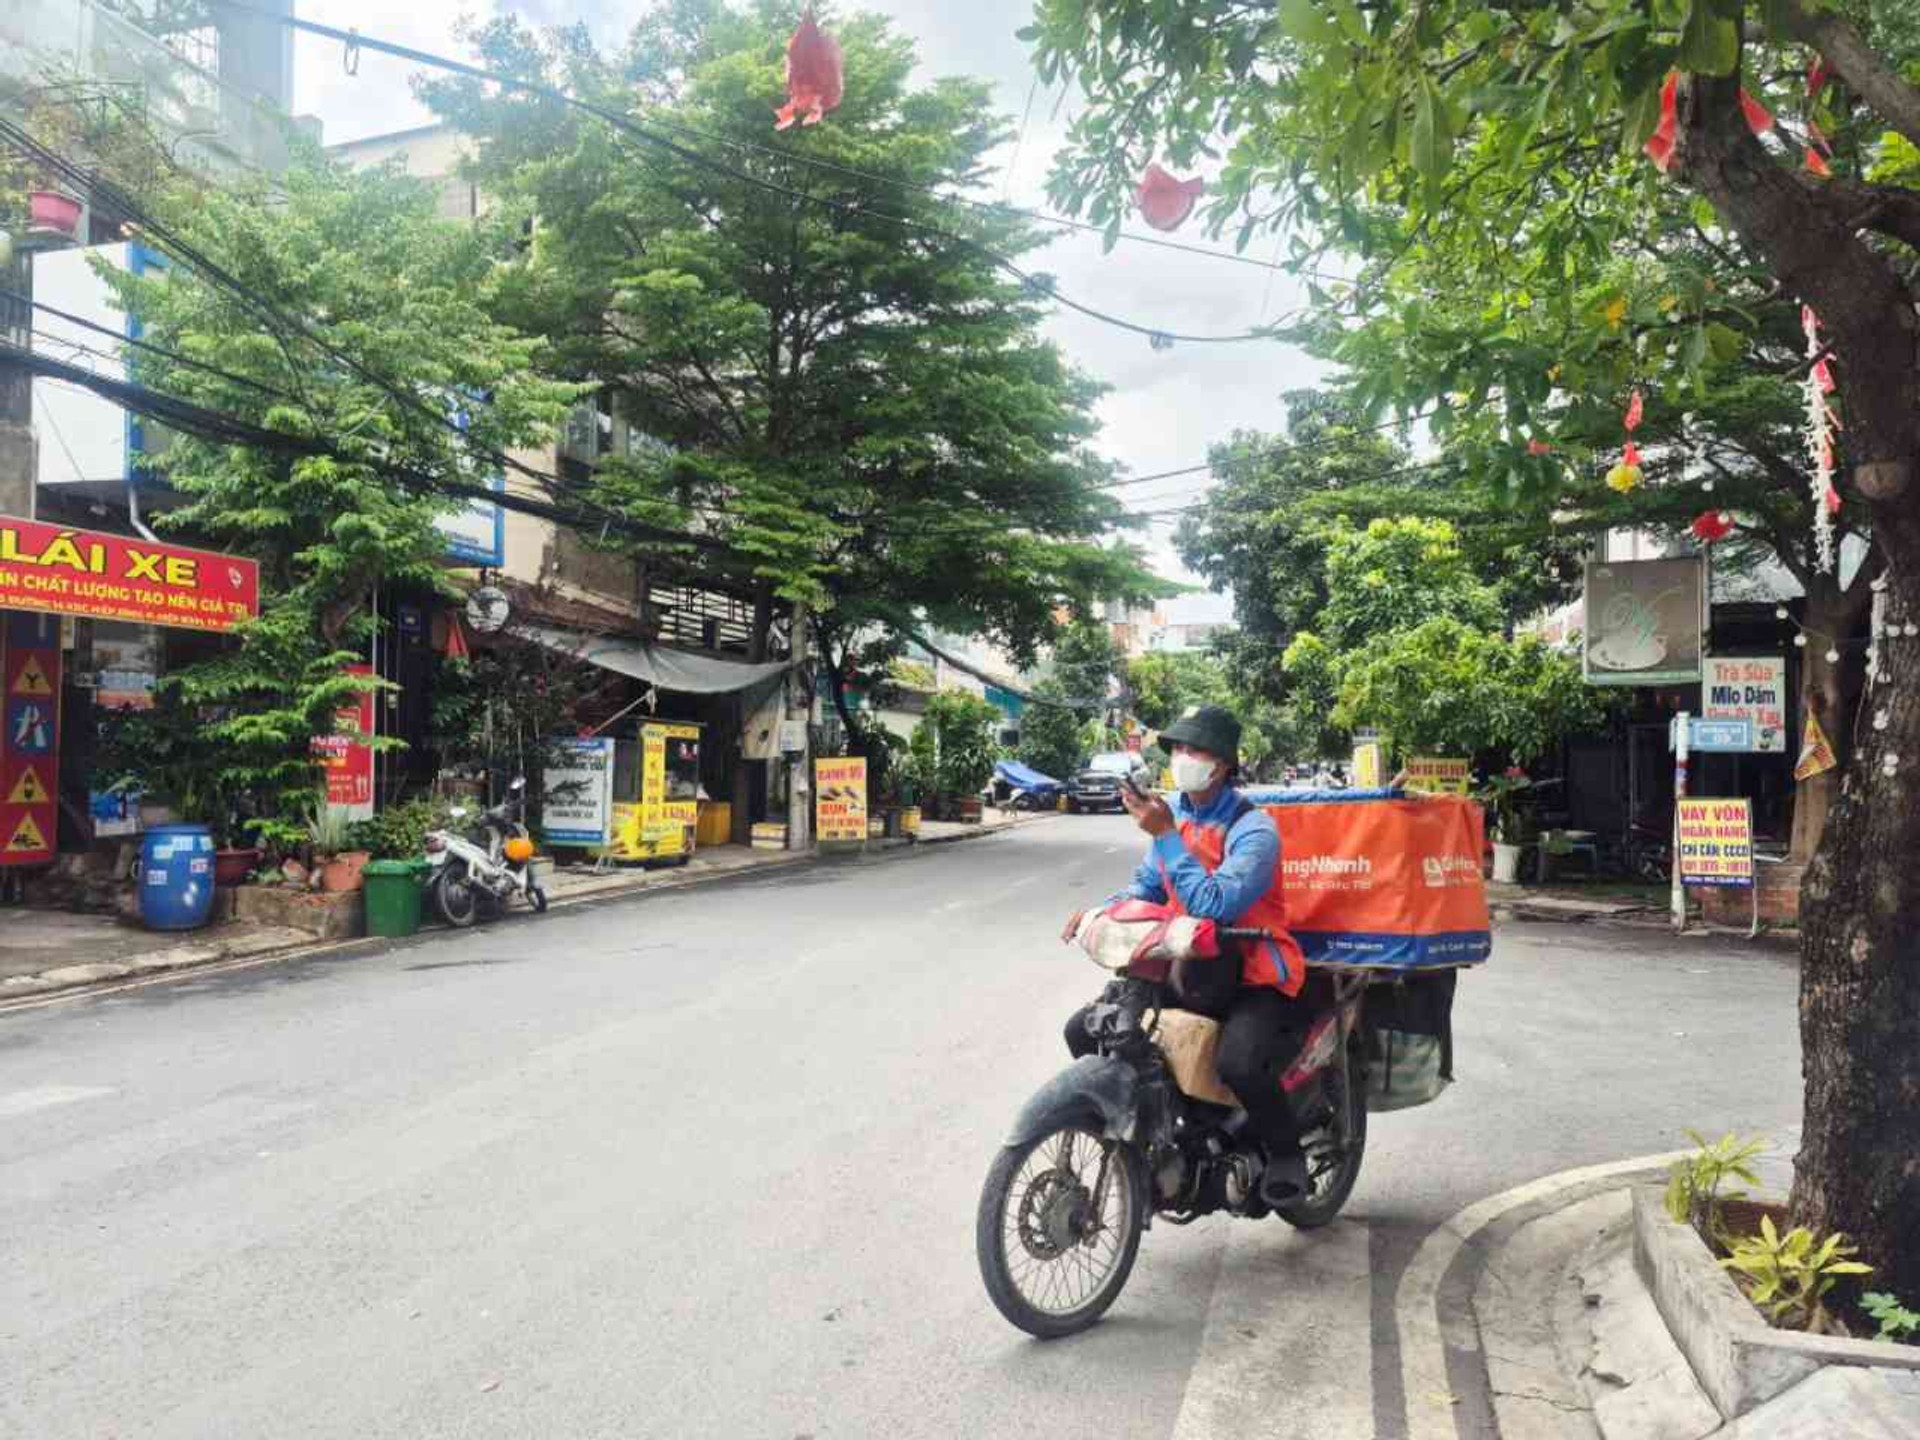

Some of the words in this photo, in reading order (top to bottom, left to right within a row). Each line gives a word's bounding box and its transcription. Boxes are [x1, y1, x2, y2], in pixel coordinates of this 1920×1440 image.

[1, 528, 105, 574] LÁI
[124, 549, 197, 588] XE
[23, 573, 68, 594] CHẤT
[1681, 806, 1706, 820] VAY
